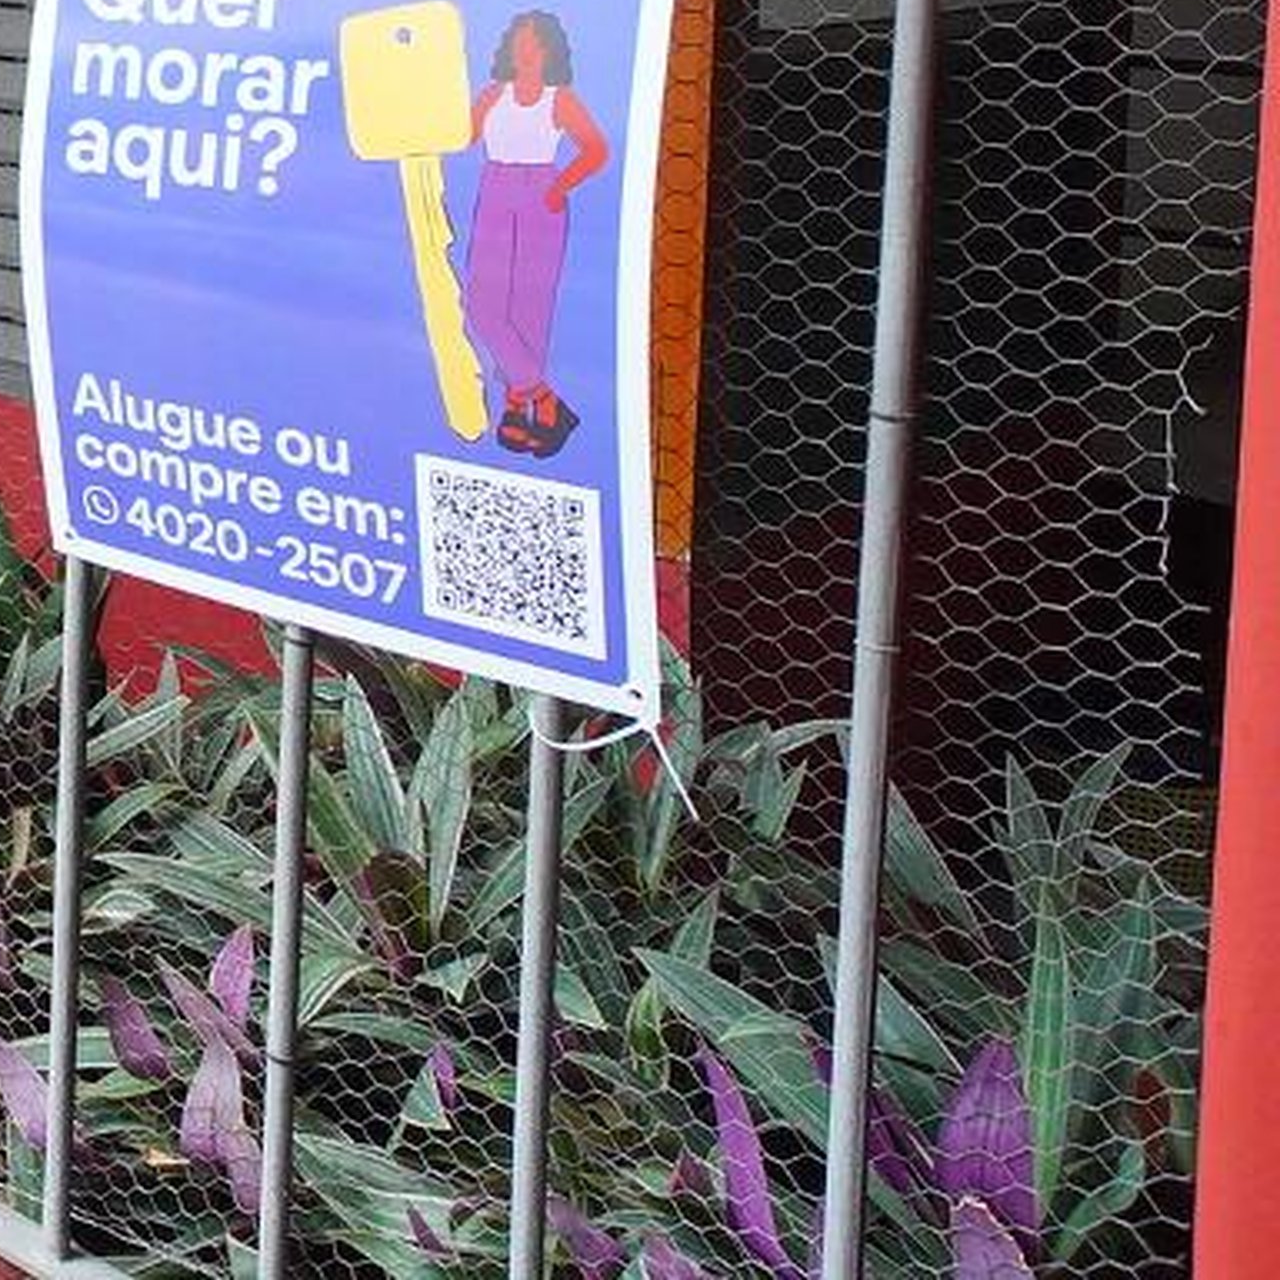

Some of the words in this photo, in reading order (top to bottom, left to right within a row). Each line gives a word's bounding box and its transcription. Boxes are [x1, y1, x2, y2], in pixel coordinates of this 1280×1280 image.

[72, 41, 330, 115] morar
[65, 113, 298, 200] aqui?
[72, 372, 262, 456] Alugue
[274, 428, 351, 477] ou
[75, 433, 283, 514] compre
[295, 486, 406, 545] em:
[125, 497, 408, 604] 4020-2507
